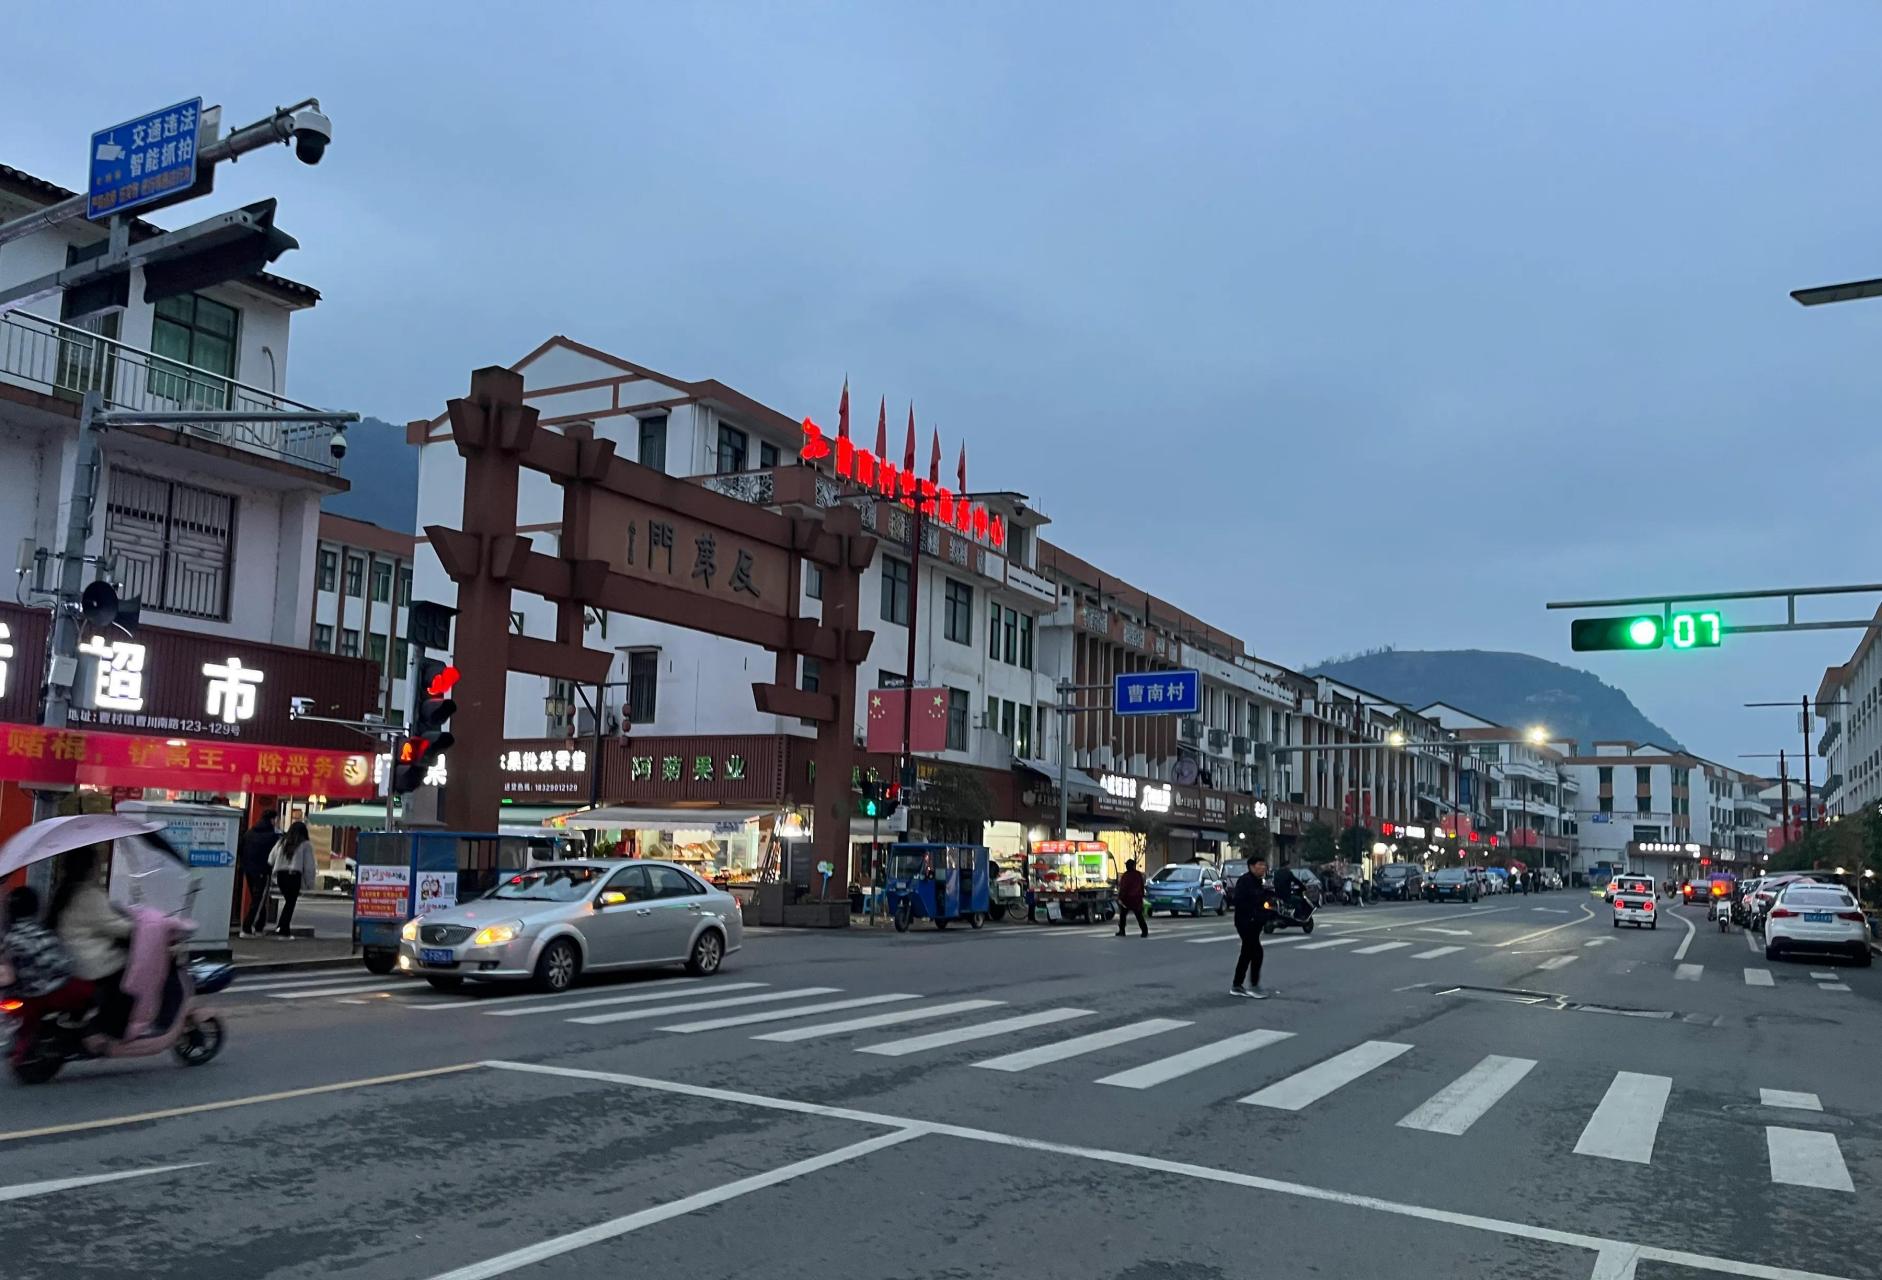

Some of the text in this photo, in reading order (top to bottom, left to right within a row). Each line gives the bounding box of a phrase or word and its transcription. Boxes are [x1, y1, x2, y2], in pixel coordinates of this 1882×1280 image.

[130, 106, 196, 150] 交通违法
[130, 136, 193, 178] 智能抓拍
[1673, 614, 1720, 648] 07
[1127, 681, 1185, 704] 曹南村
[631, 754, 745, 782] 阿菊果业
